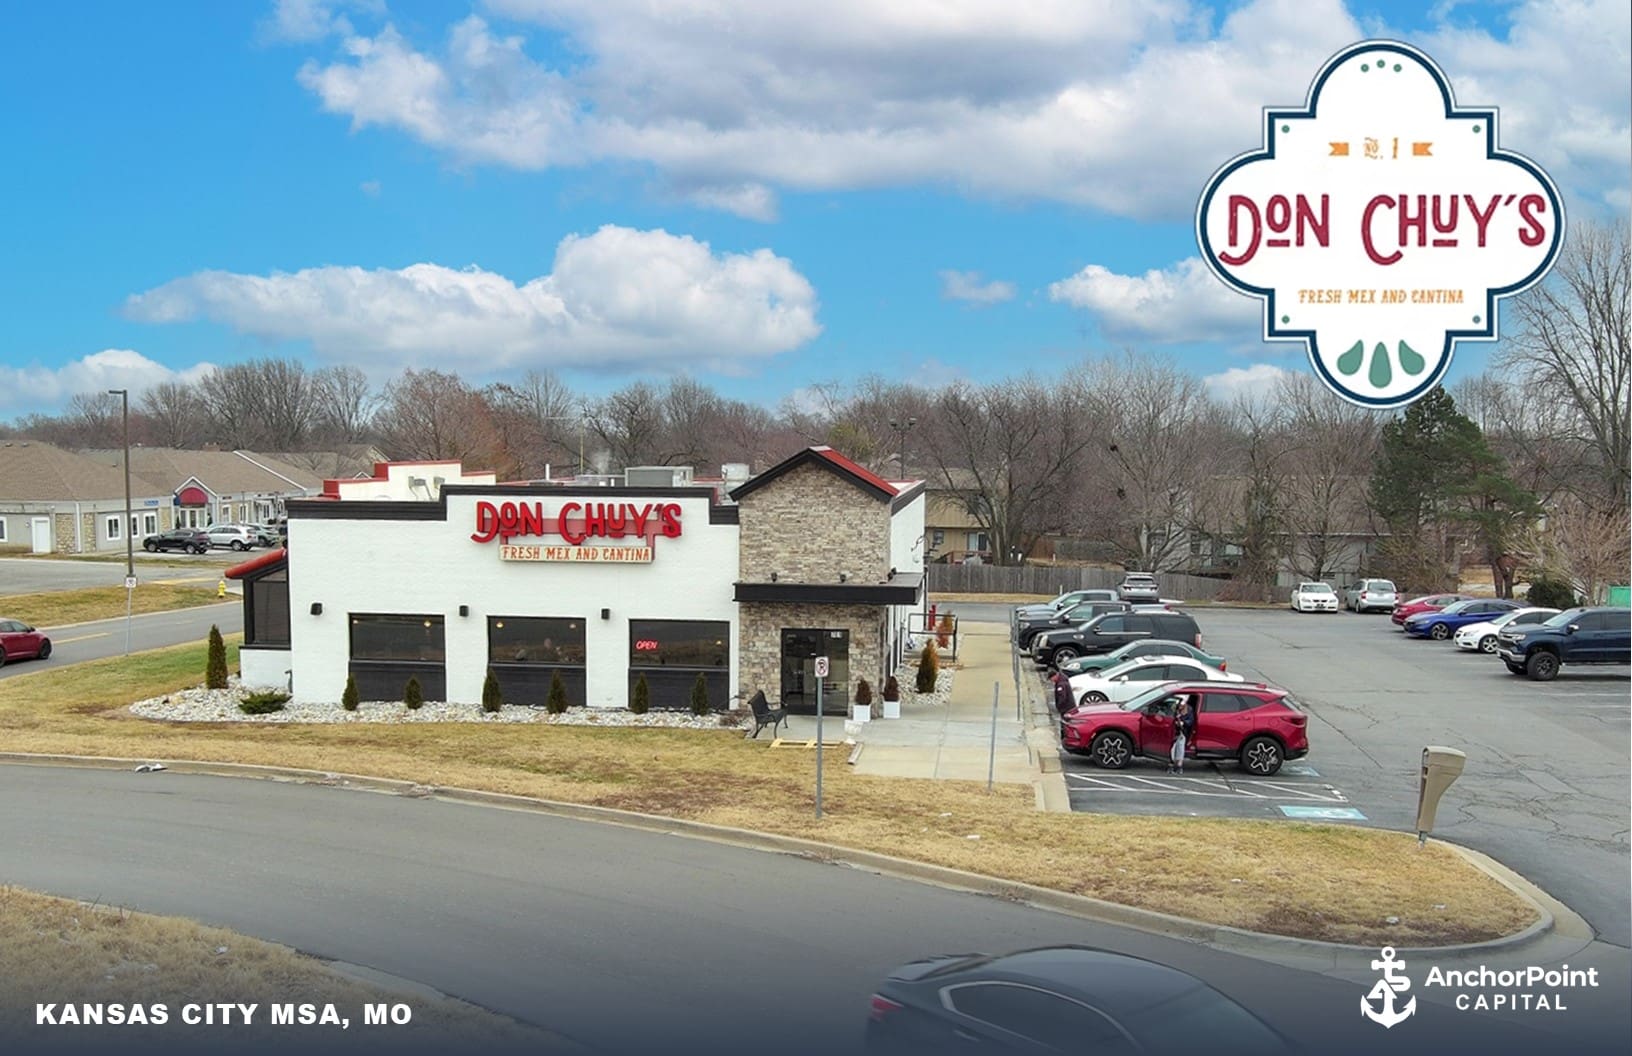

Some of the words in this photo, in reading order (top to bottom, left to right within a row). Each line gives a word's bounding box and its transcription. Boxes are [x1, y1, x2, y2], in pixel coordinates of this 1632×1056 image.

[470, 501, 543, 543] DON
[558, 502, 682, 545] CHUY'S
[503, 546, 540, 559] FRESH
[546, 547, 570, 560] MEX
[576, 548, 598, 560] AND
[603, 548, 650, 561] CANTINA
[635, 640, 658, 650] OPEN
